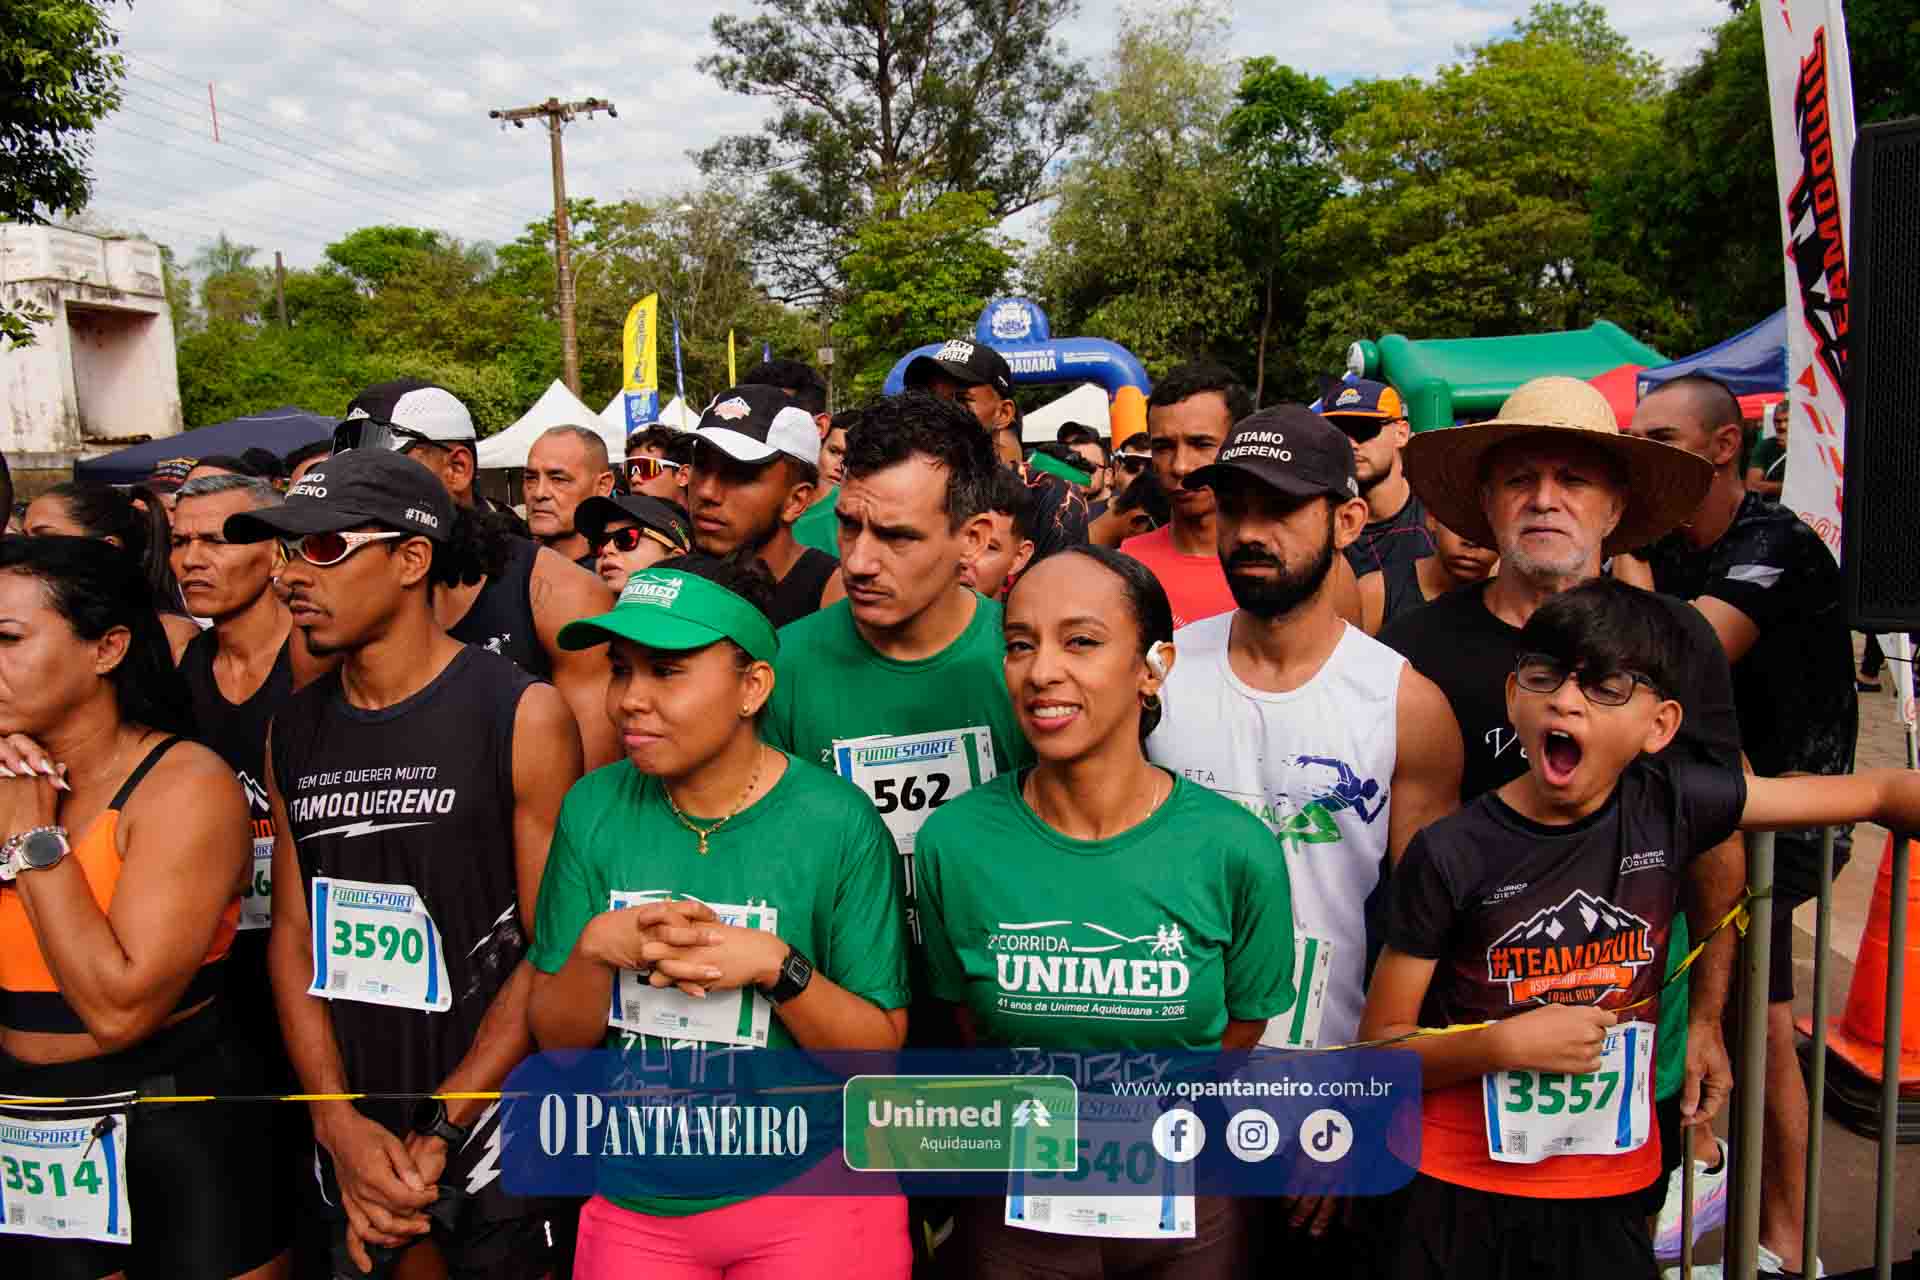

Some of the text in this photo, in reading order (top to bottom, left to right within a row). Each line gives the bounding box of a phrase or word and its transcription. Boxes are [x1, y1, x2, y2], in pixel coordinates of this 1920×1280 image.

[1222, 446, 1292, 462] QUERENO
[1234, 431, 1284, 444] #TAMO
[298, 766, 437, 790] TEM QUE QUERER MUITO
[873, 772, 951, 815] 562
[332, 920, 423, 964] 3590
[999, 935, 1070, 953] CORRIDA
[996, 954, 1190, 998] UNIMED
[1010, 1002, 1032, 1011] anos
[1050, 1003, 1090, 1013] Unimed
[1092, 1004, 1153, 1016] Aquidauana
[1505, 1071, 1620, 1115] 3557
[0, 1125, 89, 1144] UNDESPORTE
[1, 1155, 103, 1197] 3514
[1031, 1136, 1154, 1184] 3540
